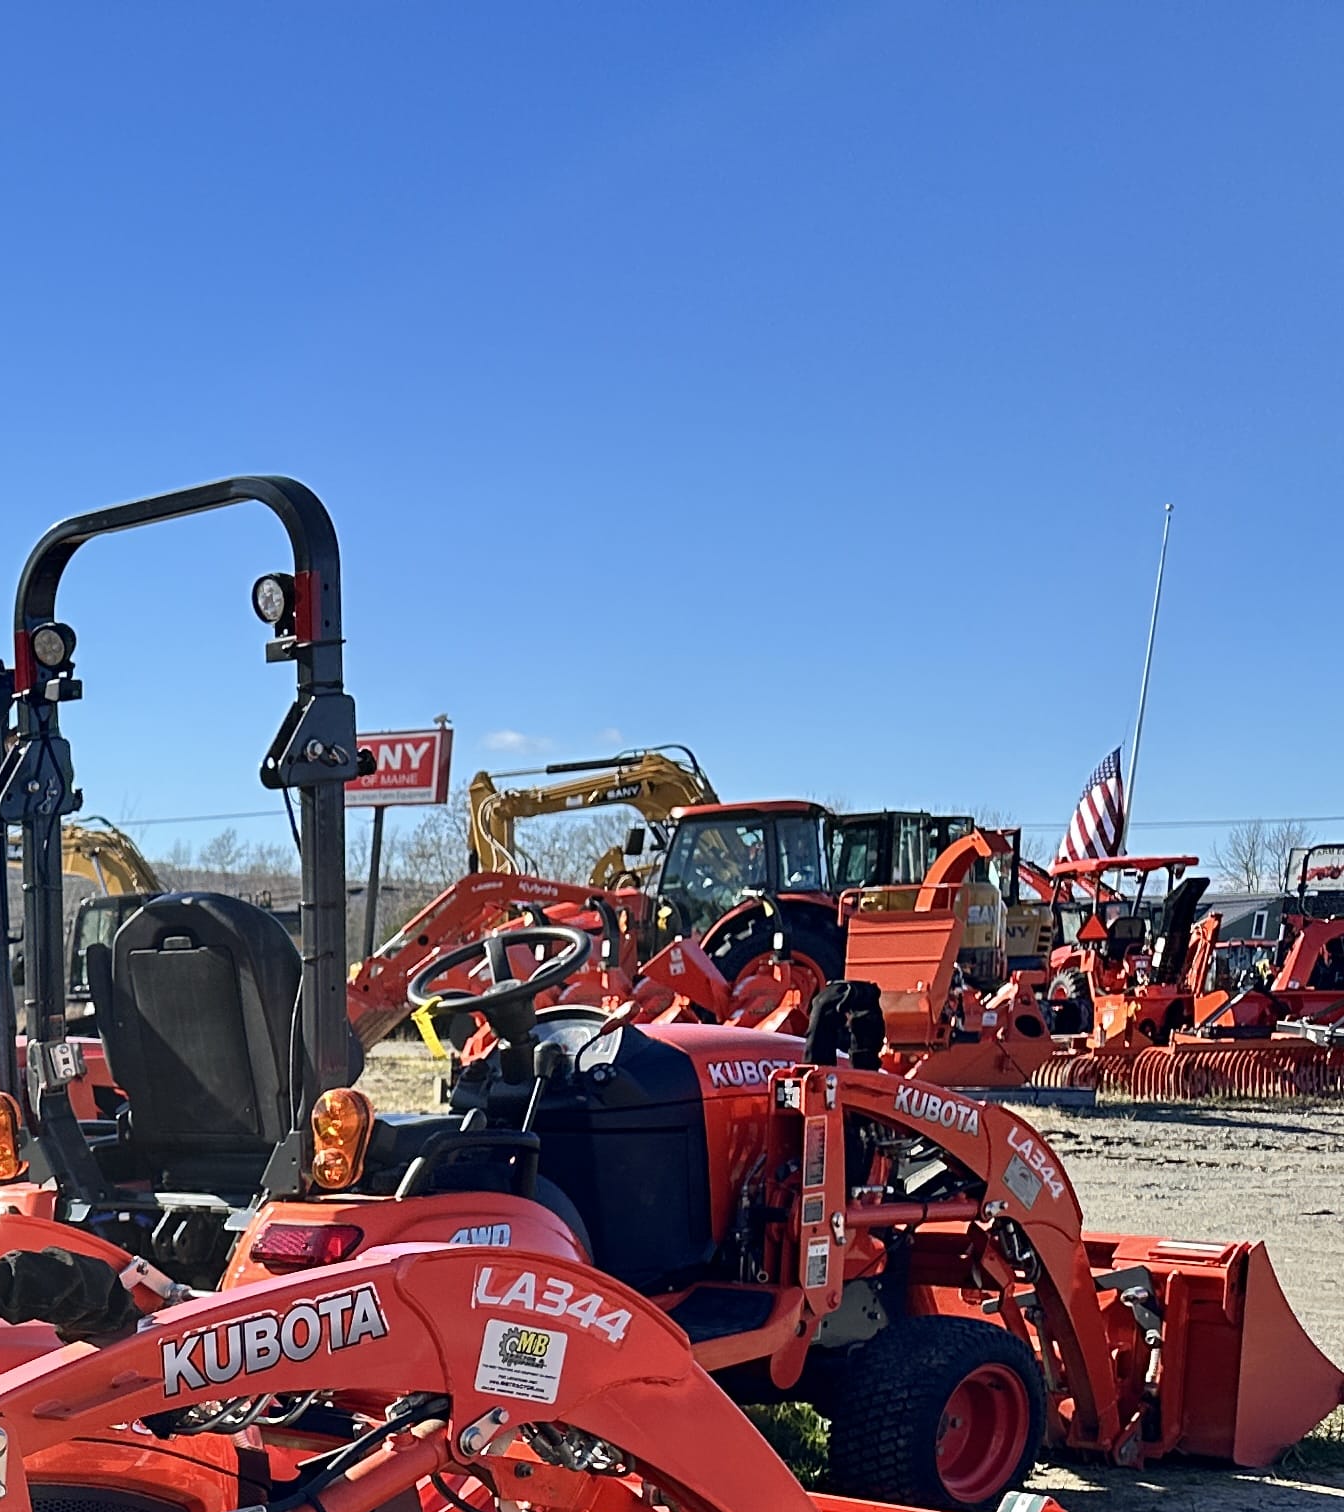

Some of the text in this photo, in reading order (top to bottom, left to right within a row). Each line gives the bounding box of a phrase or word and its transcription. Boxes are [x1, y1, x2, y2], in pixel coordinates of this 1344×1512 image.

[376, 742, 430, 771] NY
[381, 772, 418, 785] MAINE
[606, 784, 640, 800] SANY
[894, 1084, 979, 1137] KUBOTA
[1007, 1127, 1064, 1201] LA344
[449, 1223, 511, 1248] 4WD
[476, 1267, 632, 1343] LA344
[163, 1287, 388, 1397] KUBOTA
[516, 1330, 551, 1357] MB
